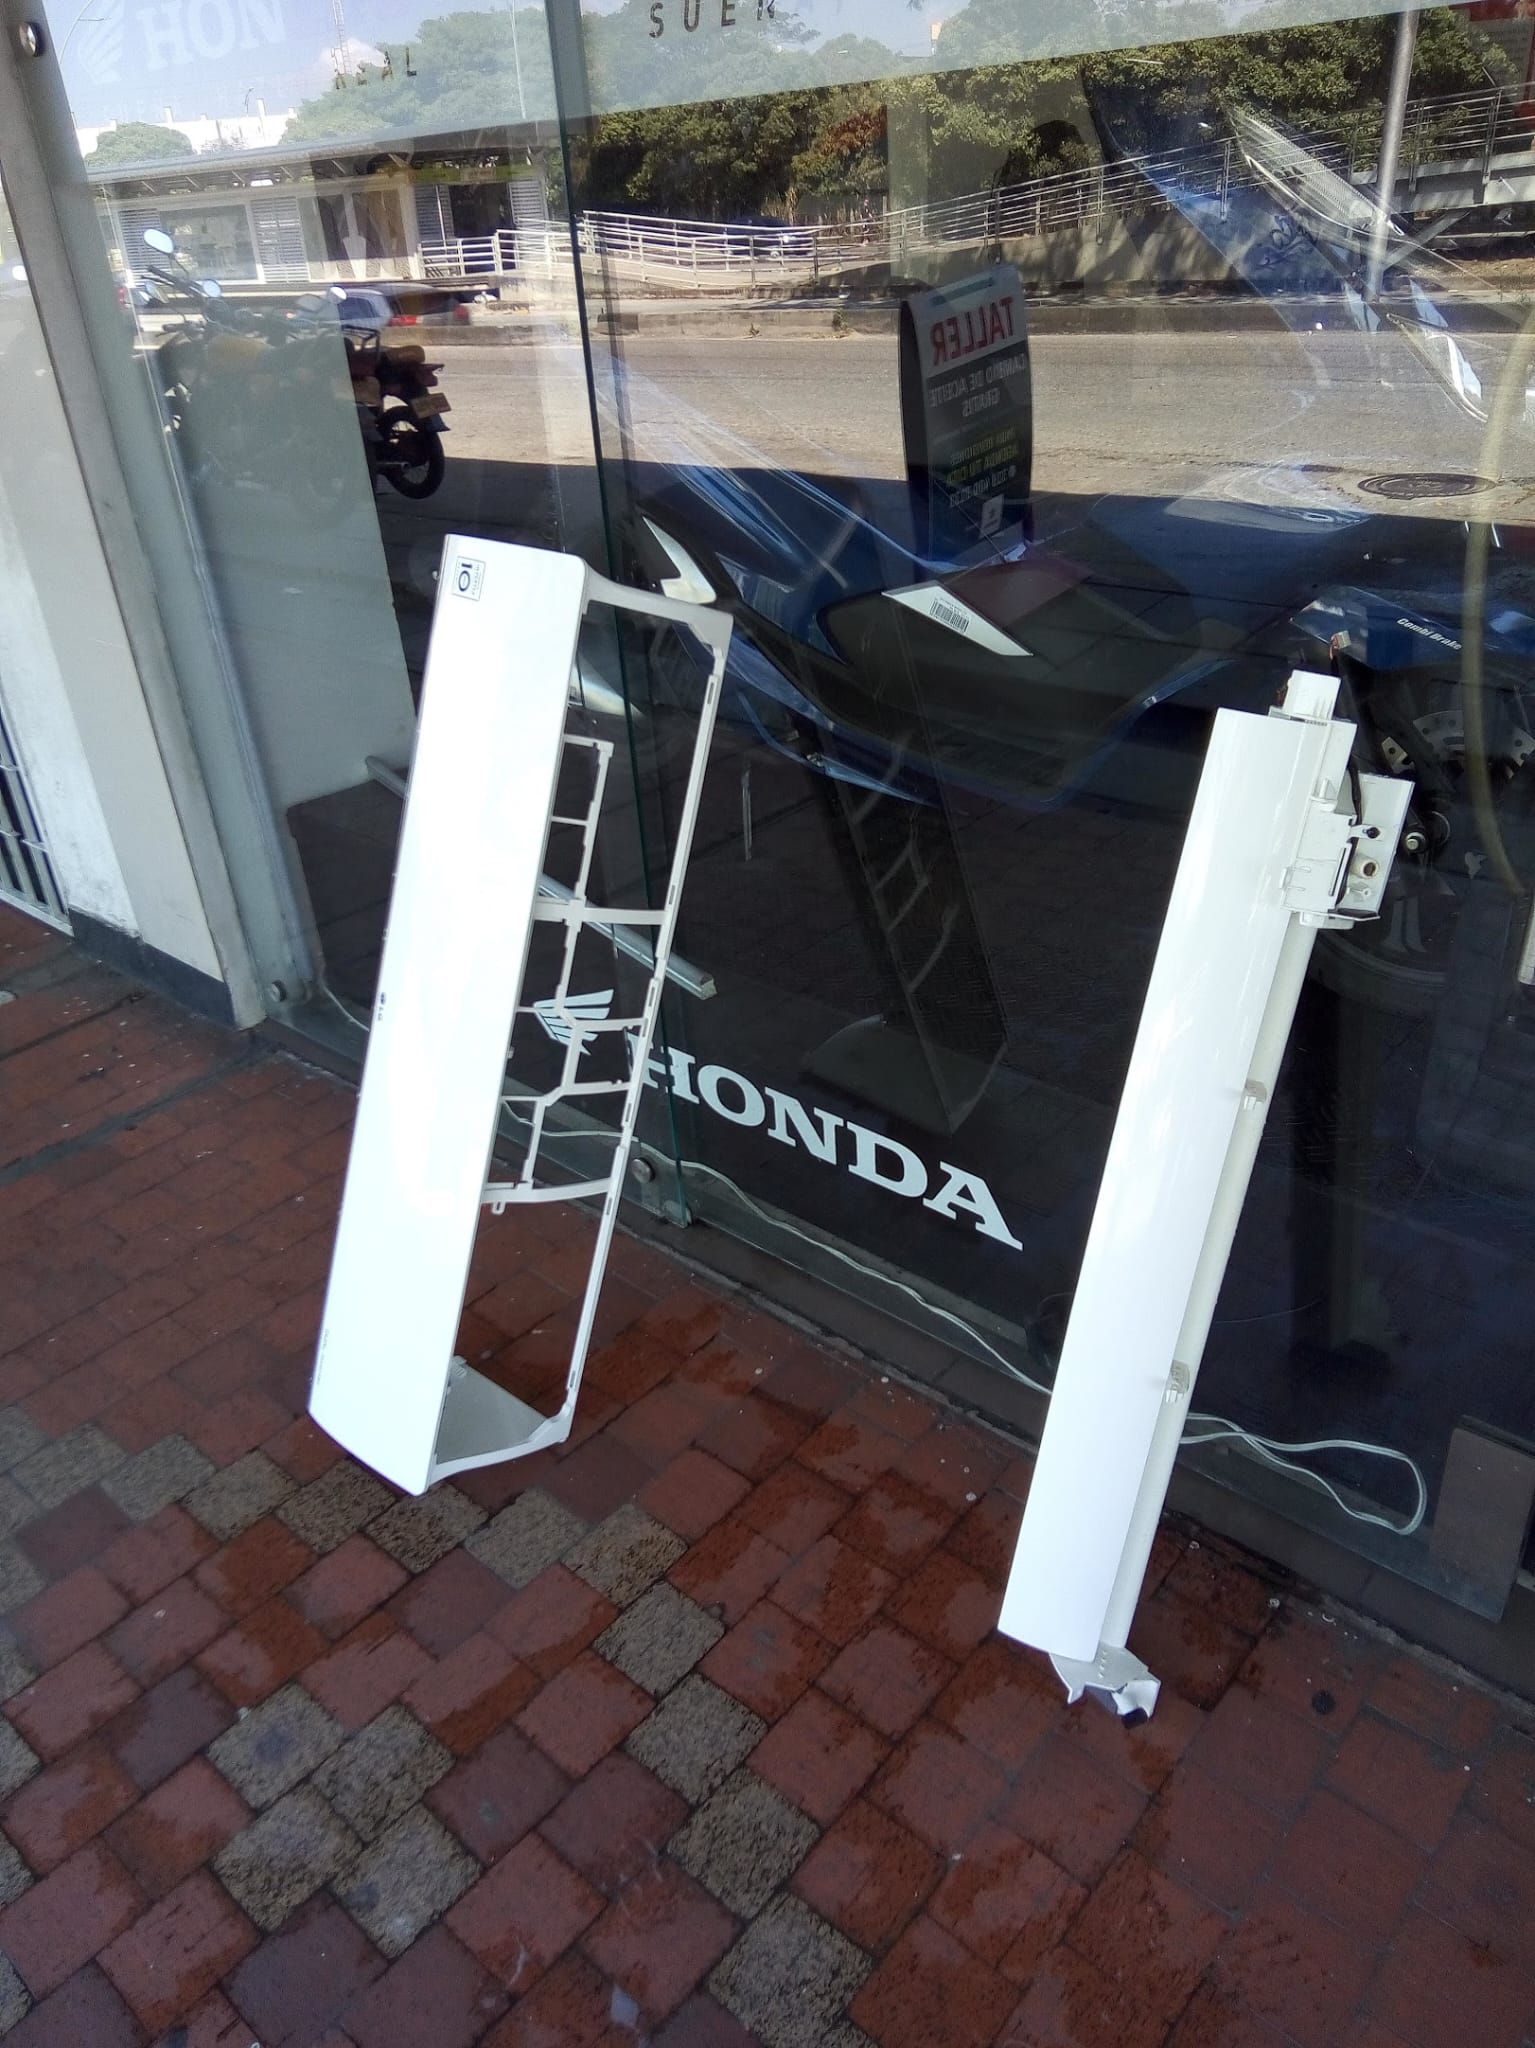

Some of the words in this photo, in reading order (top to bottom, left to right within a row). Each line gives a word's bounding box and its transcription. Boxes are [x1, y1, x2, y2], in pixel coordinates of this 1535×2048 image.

[1396, 617, 1435, 637] Combi
[1428, 632, 1462, 651] Brake
[625, 1031, 1024, 1253] HONDA
